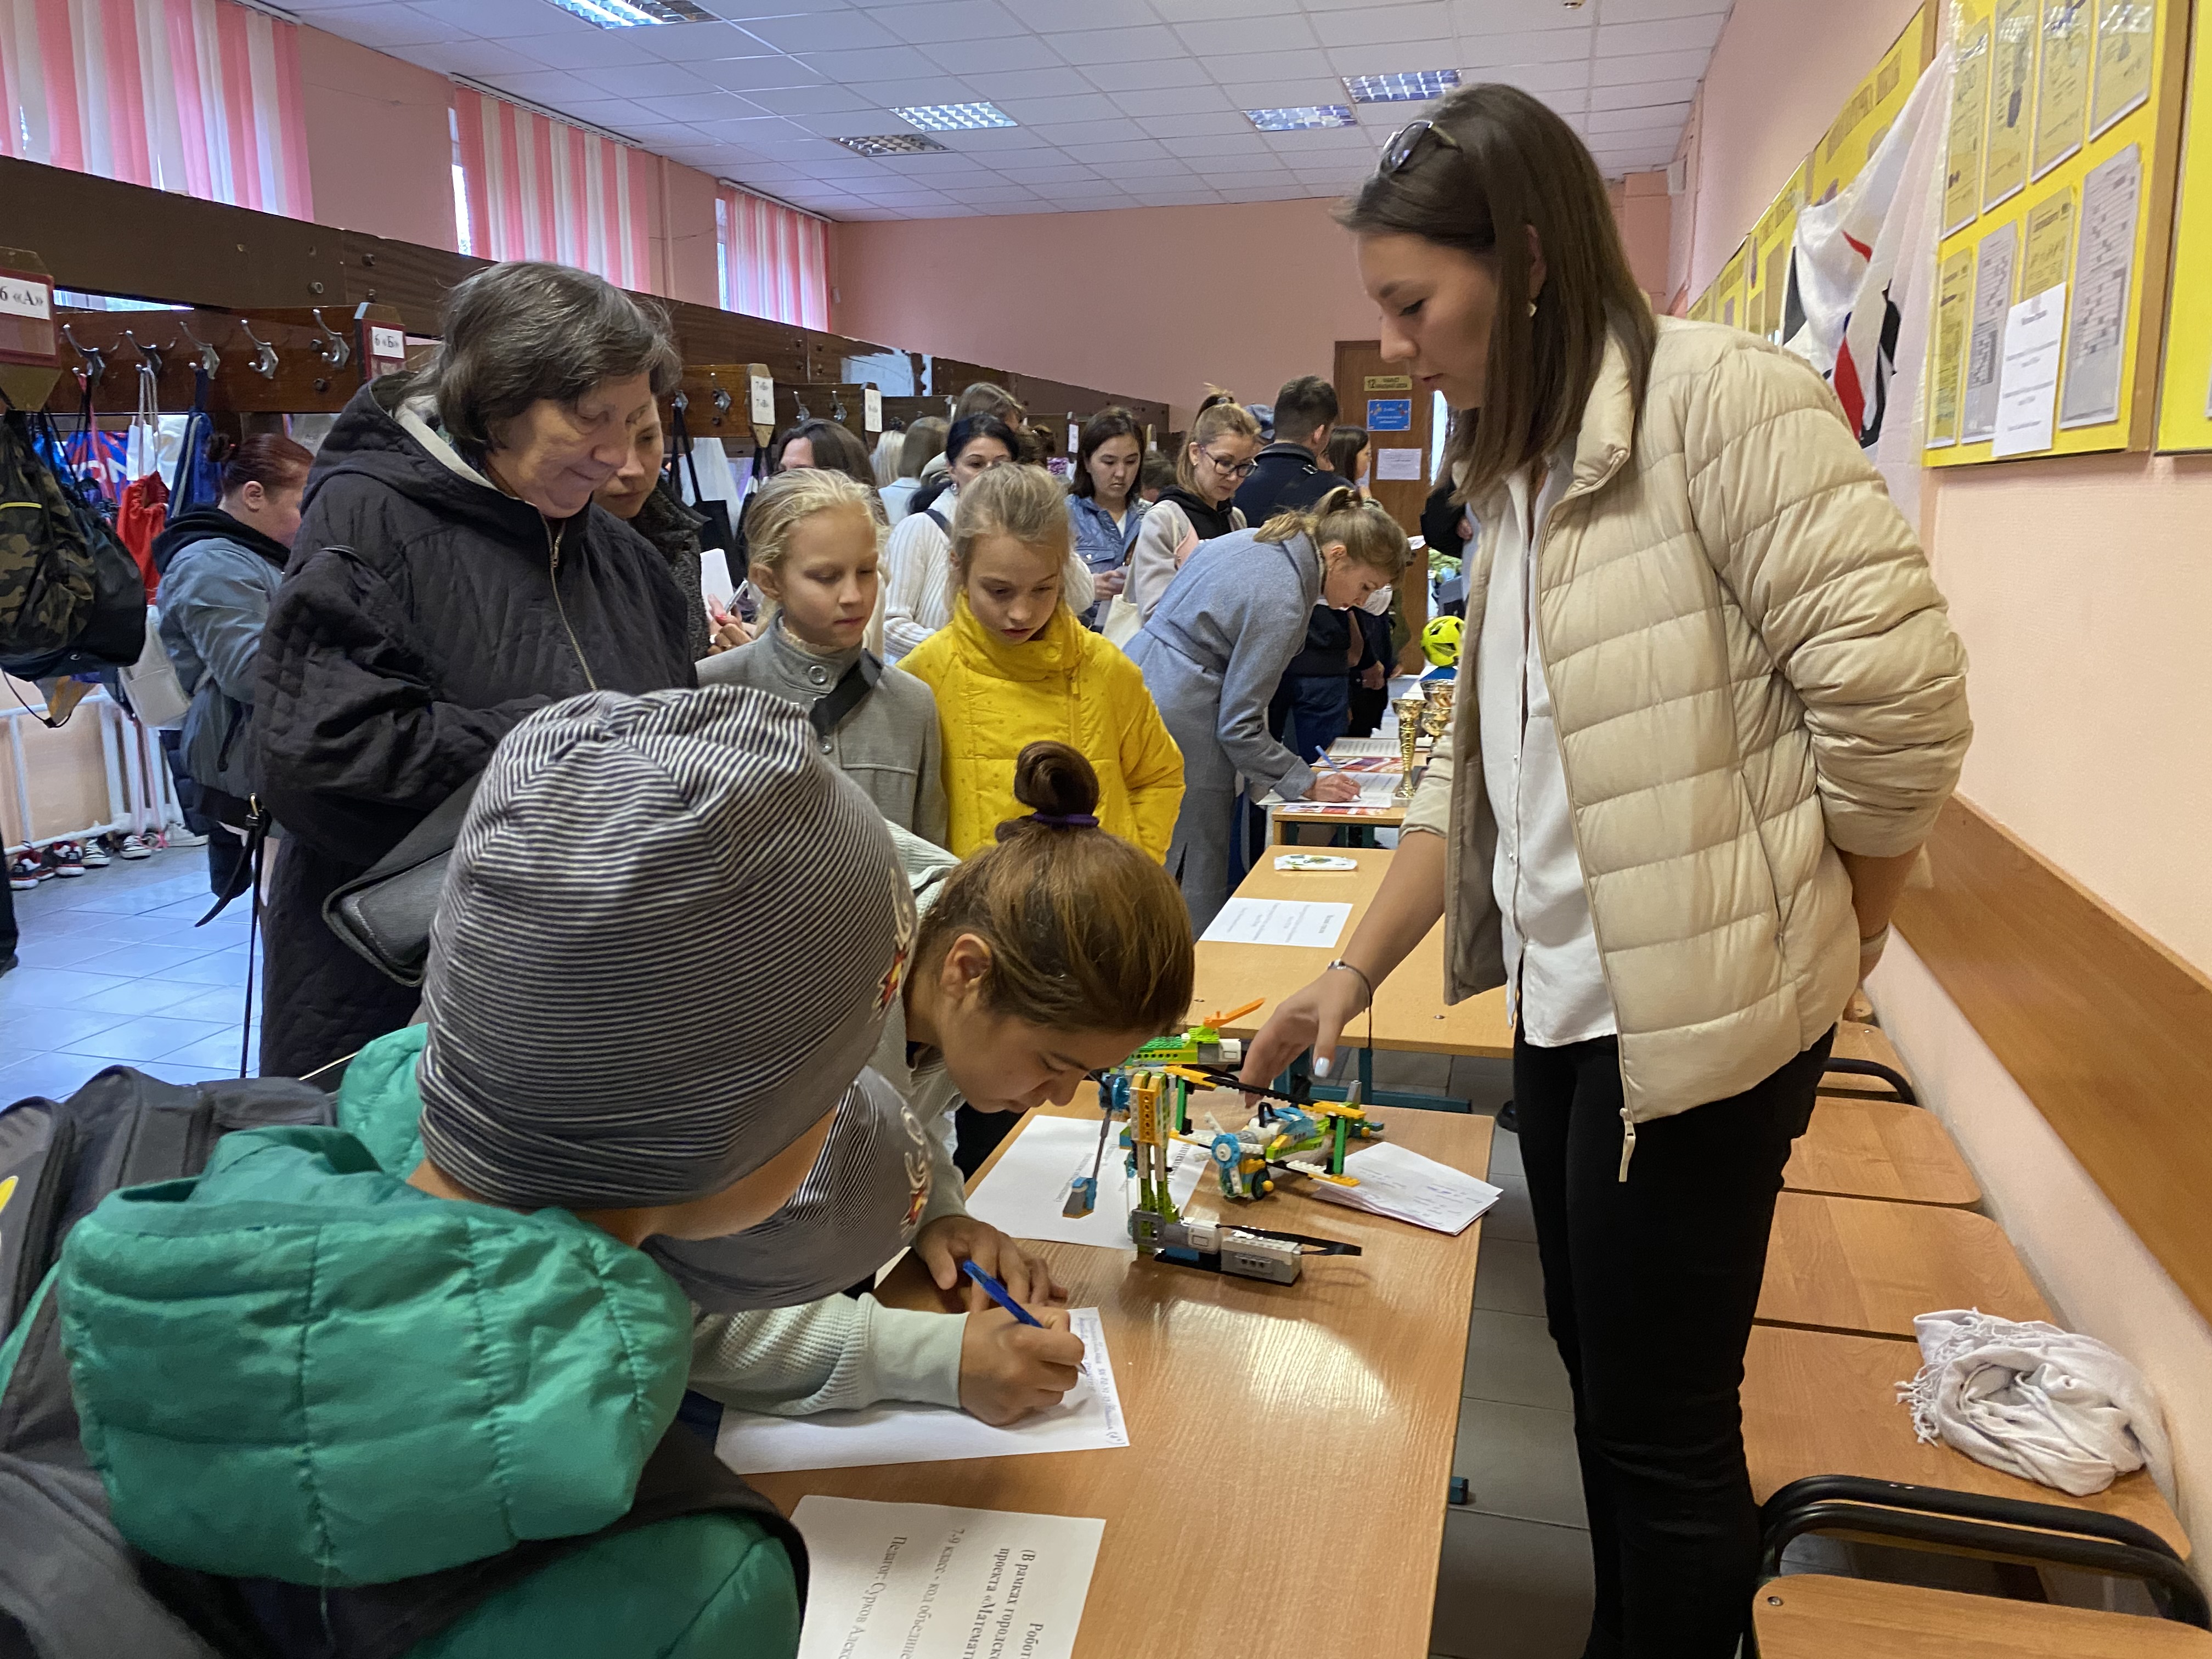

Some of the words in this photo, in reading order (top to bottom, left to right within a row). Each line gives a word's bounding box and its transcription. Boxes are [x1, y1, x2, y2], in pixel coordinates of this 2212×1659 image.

[0, 286, 8, 301] 6
[13, 290, 43, 306] «А»
[375, 334, 380, 346] 6
[986, 1548, 1010, 1592] проекта
[1007, 1564, 1029, 1604] рамках
[856, 1582, 887, 1623] Сурков
[1020, 1623, 1044, 1659] Робот
